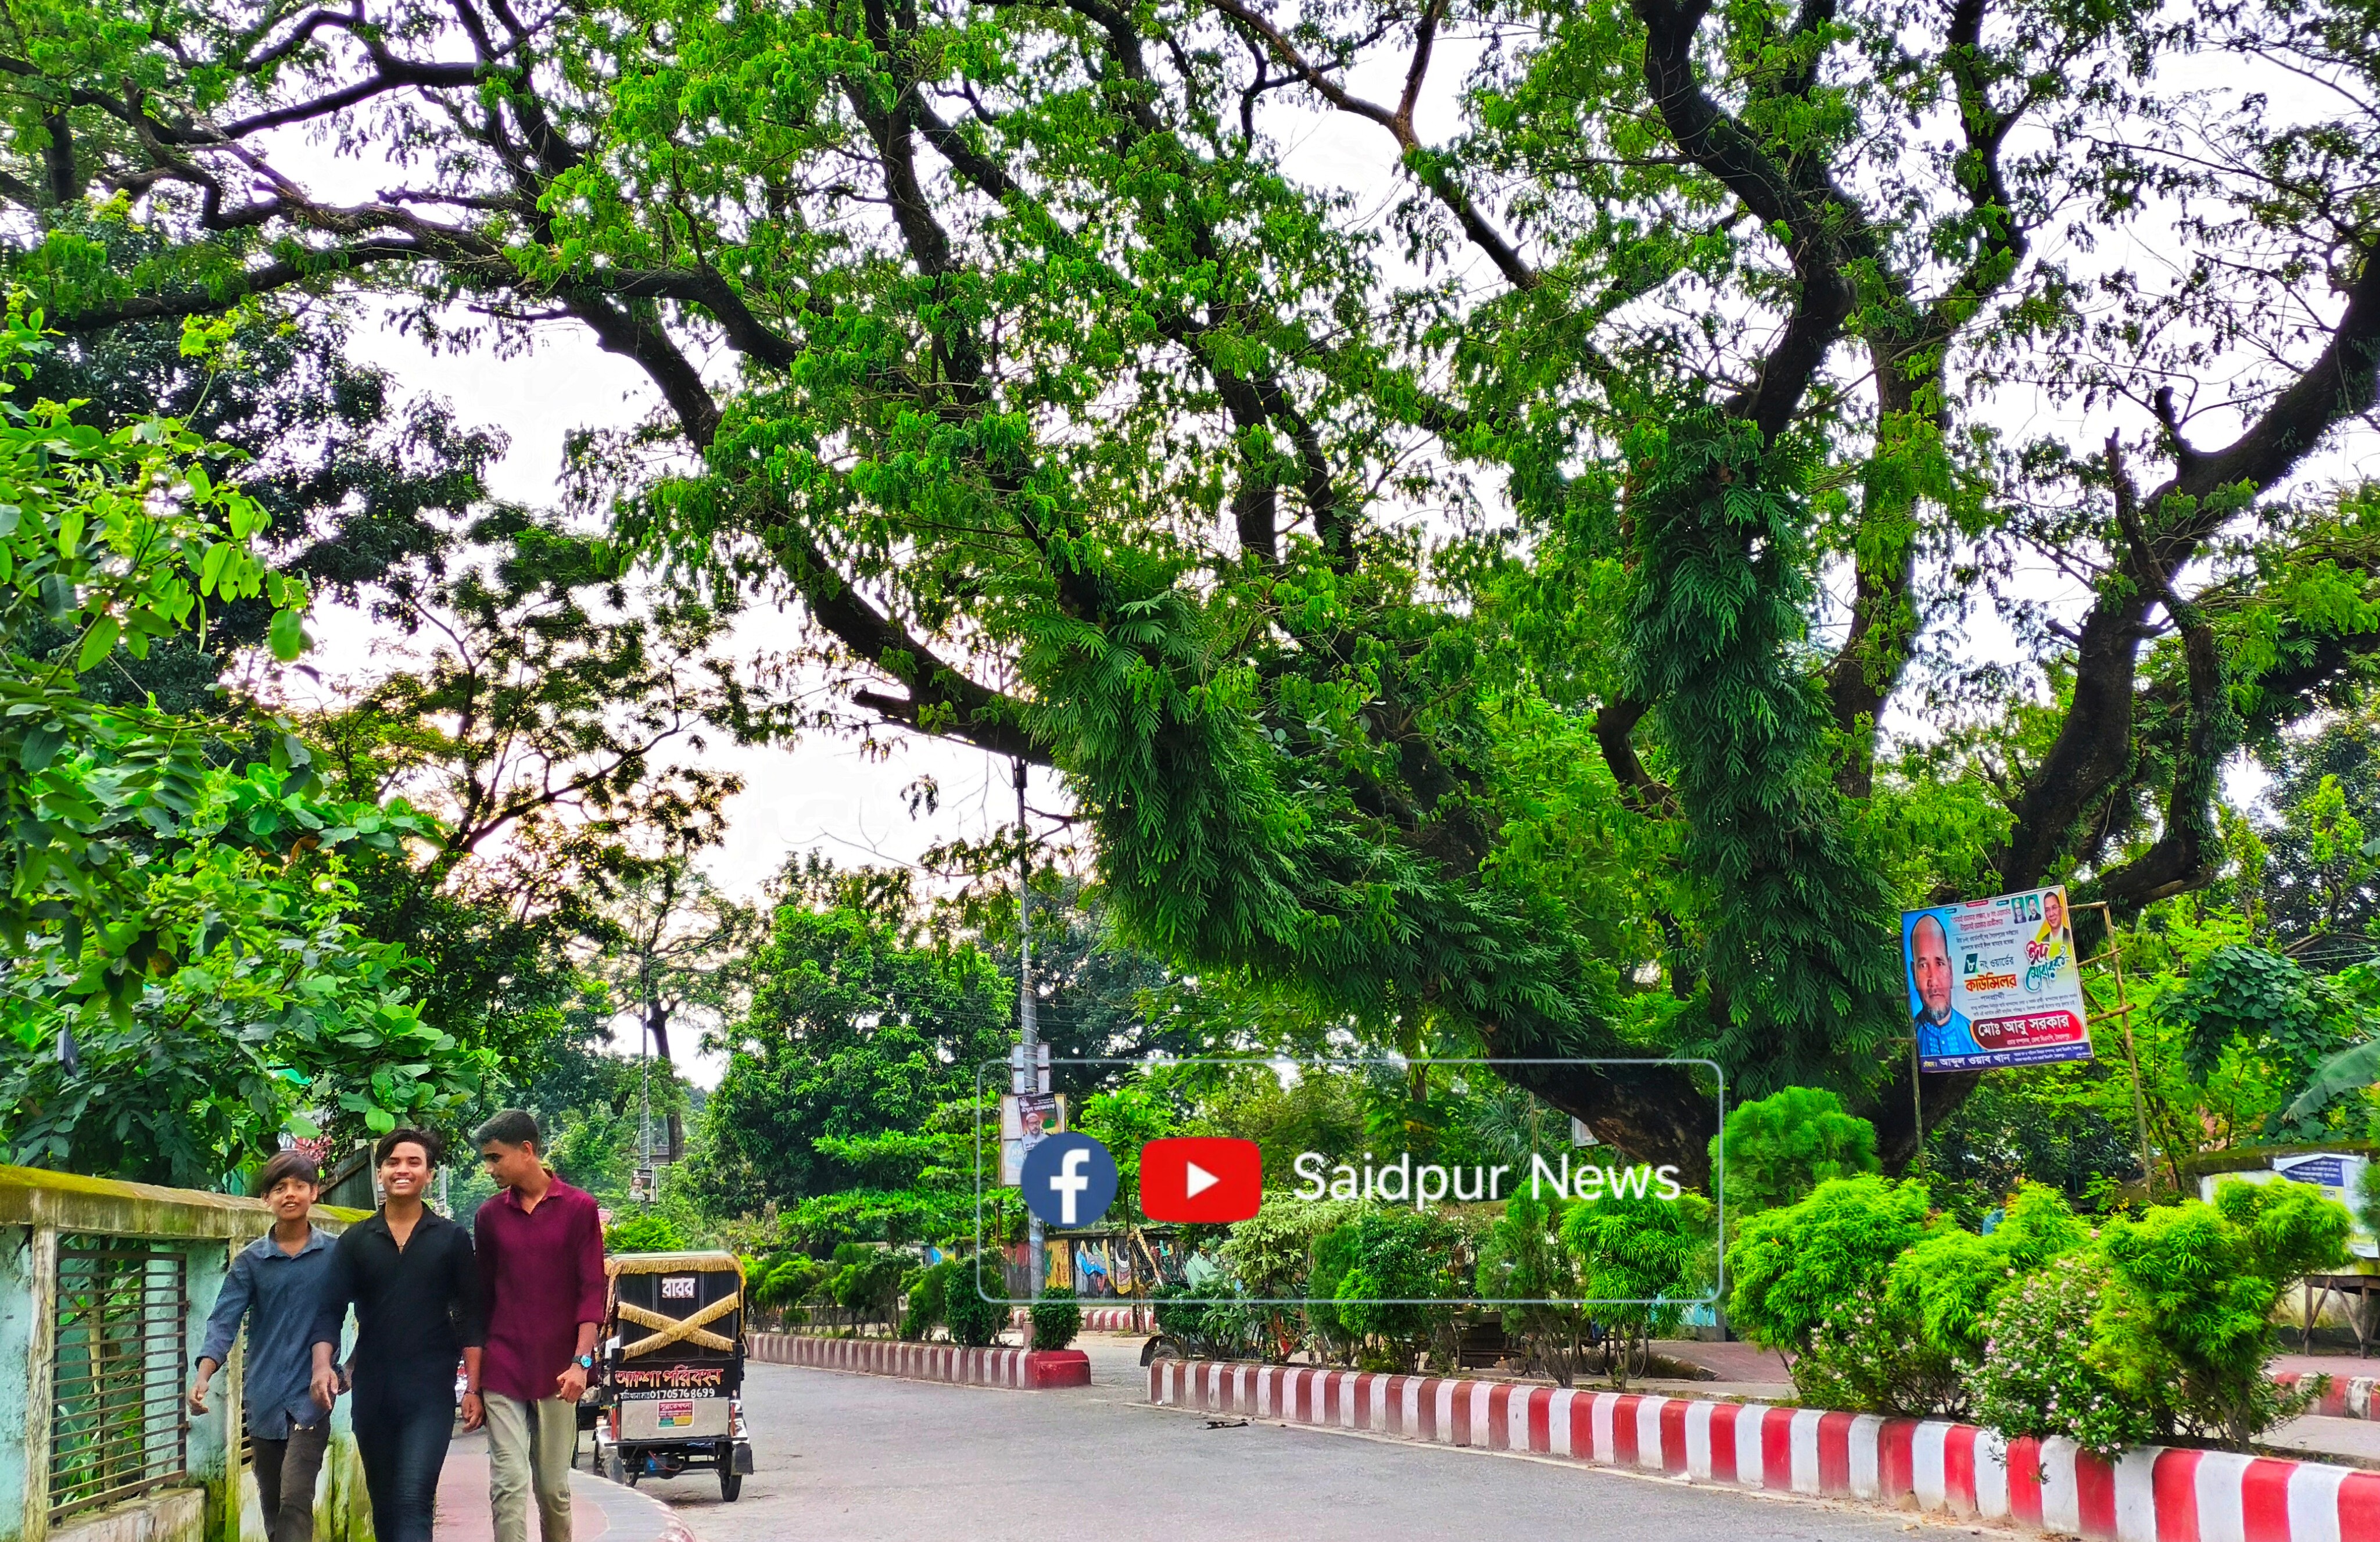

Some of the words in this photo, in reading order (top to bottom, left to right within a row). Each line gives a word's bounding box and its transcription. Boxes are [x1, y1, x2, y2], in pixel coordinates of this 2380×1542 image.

[1966, 959, 1975, 971] ৮
[1980, 960, 1988, 969] নং
[1990, 954, 2014, 968] ওয়ার্ডের
[1965, 972, 2017, 992] কাউন্সিলর
[1978, 1022, 2001, 1036] মোঃ
[2002, 1019, 2028, 1036] আবু
[2028, 1014, 2069, 1032] সরকার
[662, 1364, 724, 1387] পরিবহন
[650, 1388, 715, 1399] 01705768699
